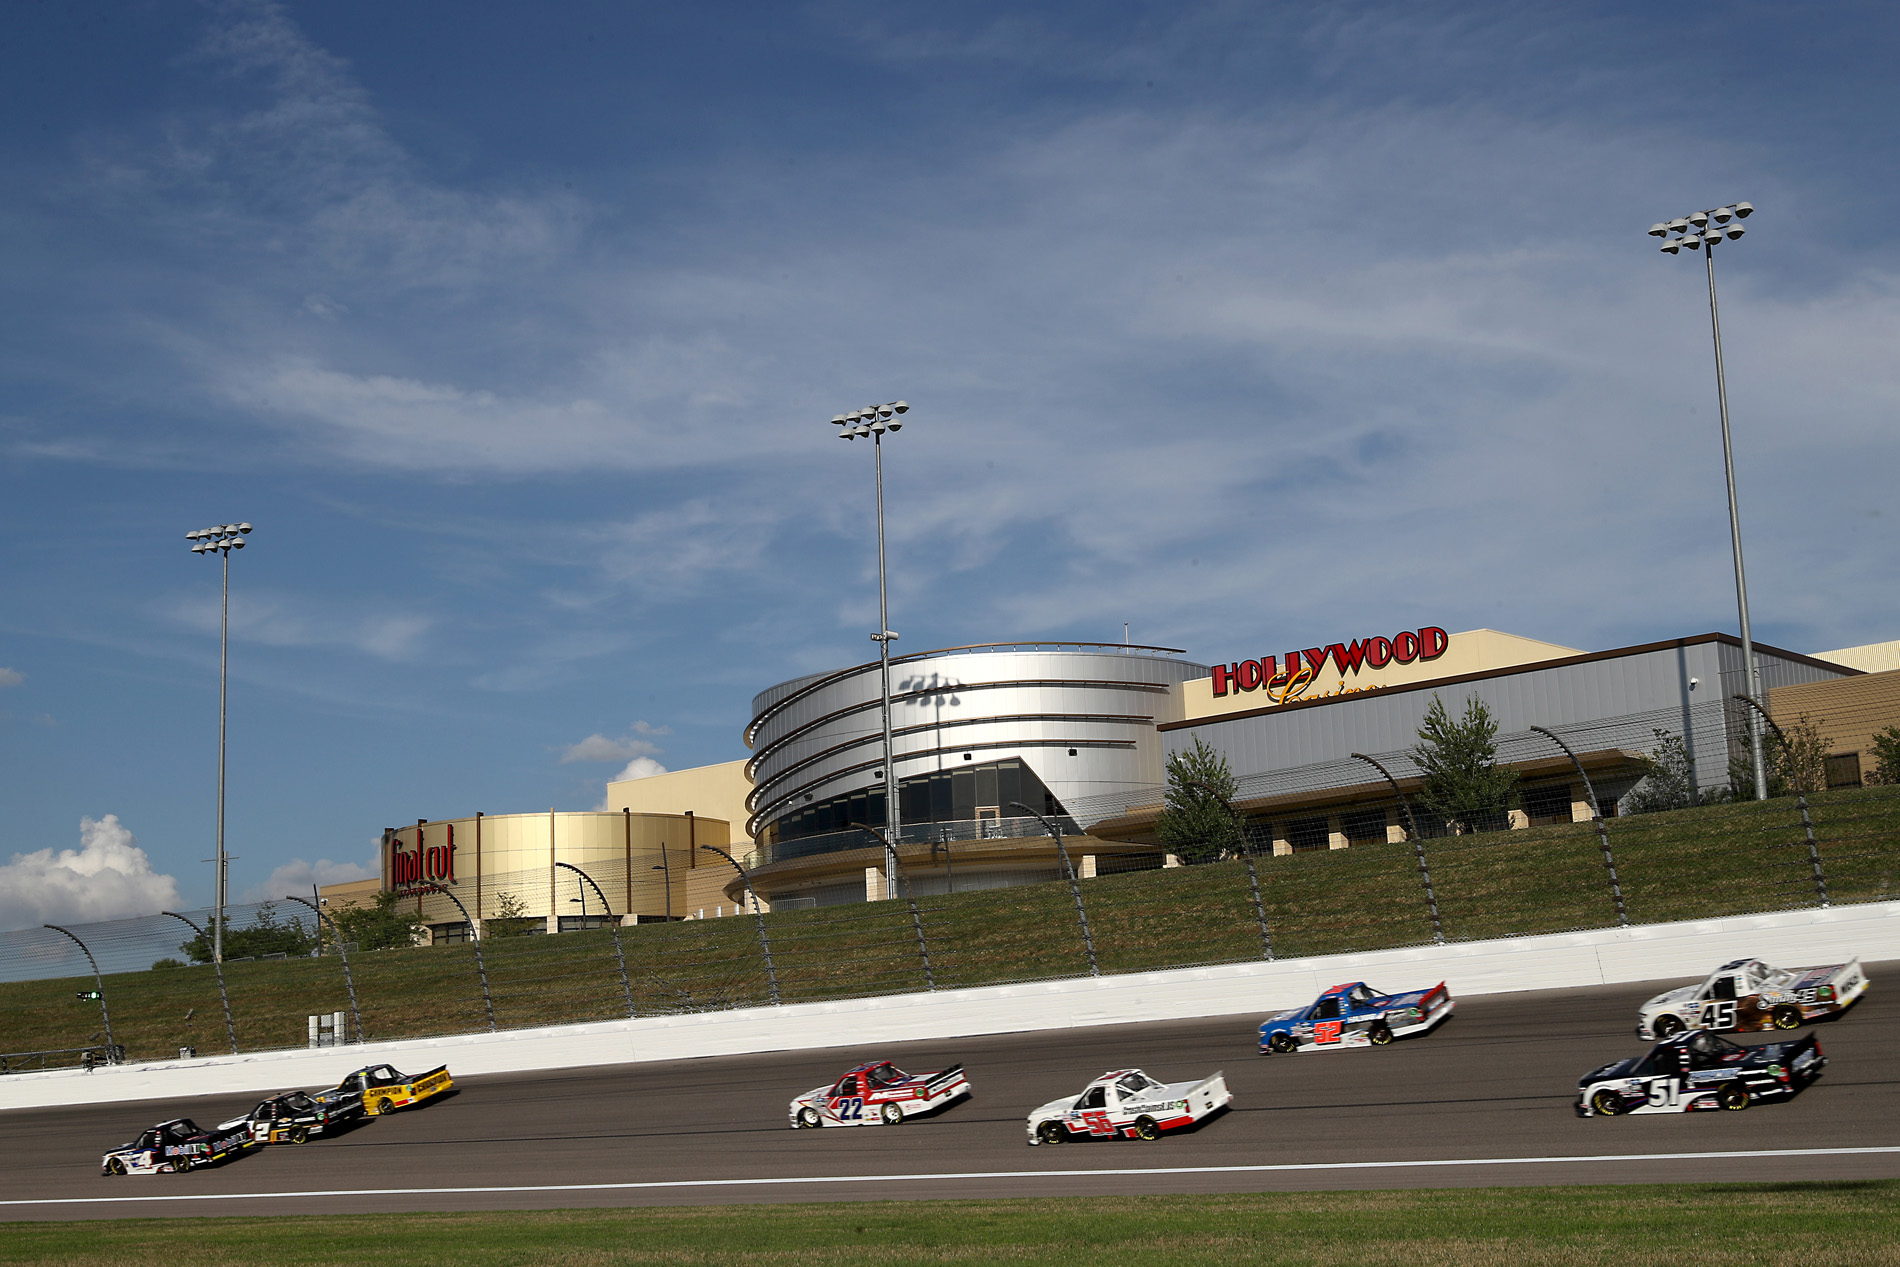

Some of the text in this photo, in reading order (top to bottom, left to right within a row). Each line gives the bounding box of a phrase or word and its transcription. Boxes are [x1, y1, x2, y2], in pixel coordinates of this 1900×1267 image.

[1211, 626, 1449, 699] HOLLYWOOD
[391, 824, 458, 894] final cut
[1701, 1001, 1738, 1030] 45
[1314, 1021, 1342, 1044] 52
[1648, 1078, 1680, 1107] 51
[839, 1098, 863, 1121] 22
[255, 1123, 271, 1141] 2
[1081, 1110, 1118, 1136] 56
[138, 1150, 153, 1170] 4
